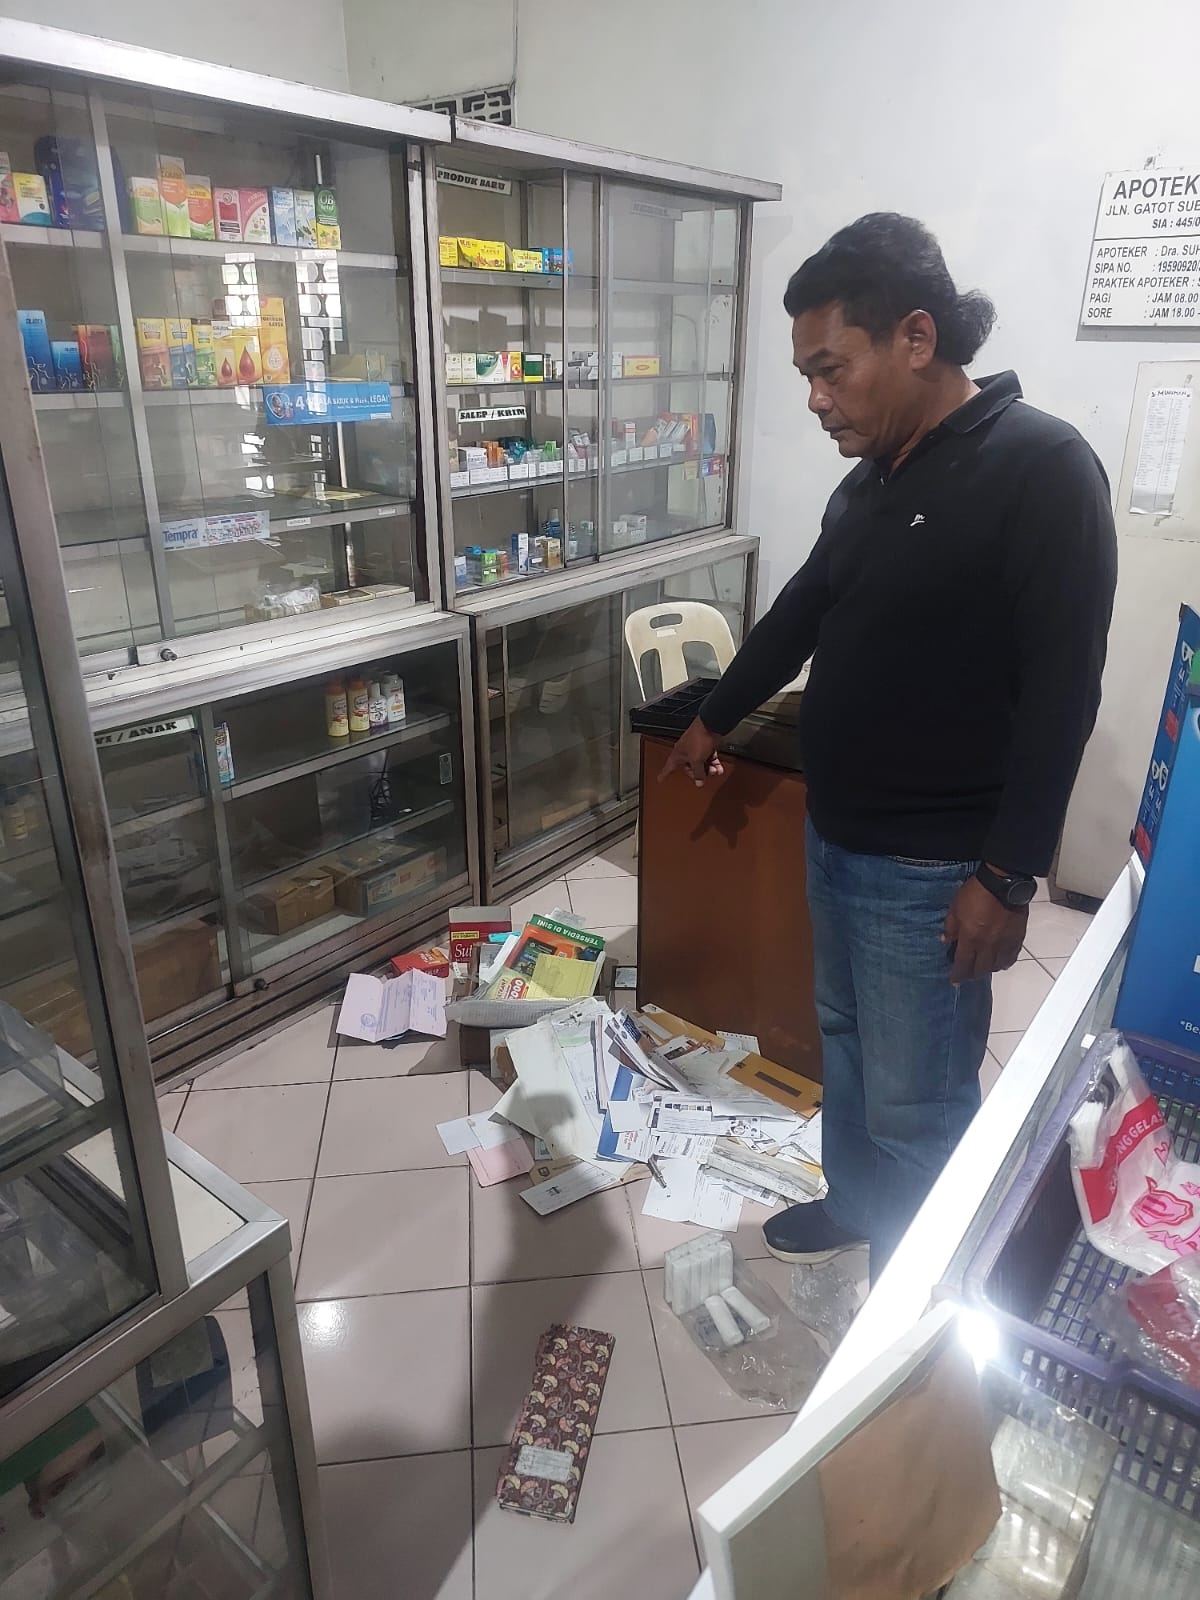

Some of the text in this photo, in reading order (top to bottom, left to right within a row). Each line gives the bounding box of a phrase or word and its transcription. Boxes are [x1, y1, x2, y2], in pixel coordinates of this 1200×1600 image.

[437, 170, 506, 191] PRODUK BARU
[1113, 175, 1200, 200] APOTEK
[1105, 204, 1130, 216] JLN.
[1134, 201, 1175, 215] GATOT
[1152, 218, 1168, 229] SIA
[1097, 246, 1148, 258] APOTEKER
[1160, 245, 1179, 257] Dra.
[1094, 262, 1115, 274] SIPA
[1116, 262, 1132, 273] NO.
[1092, 277, 1136, 288] PRAKTEK
[1137, 276, 1190, 288] APOTEKER
[1089, 292, 1112, 303] PAGI
[1151, 292, 1172, 303] JAM
[1174, 292, 1199, 303] 08.00
[1087, 307, 1113, 318] SORE
[1149, 307, 1170, 318] JAM
[1171, 307, 1195, 318] 18.00
[459, 410, 488, 420] SALEP
[497, 408, 526, 418] KRIM
[162, 528, 199, 543] Tempra
[128, 721, 177, 739] ANAK
[536, 919, 600, 947] TERSEDIA DI SINI
[1180, 1019, 1200, 1035] Be
